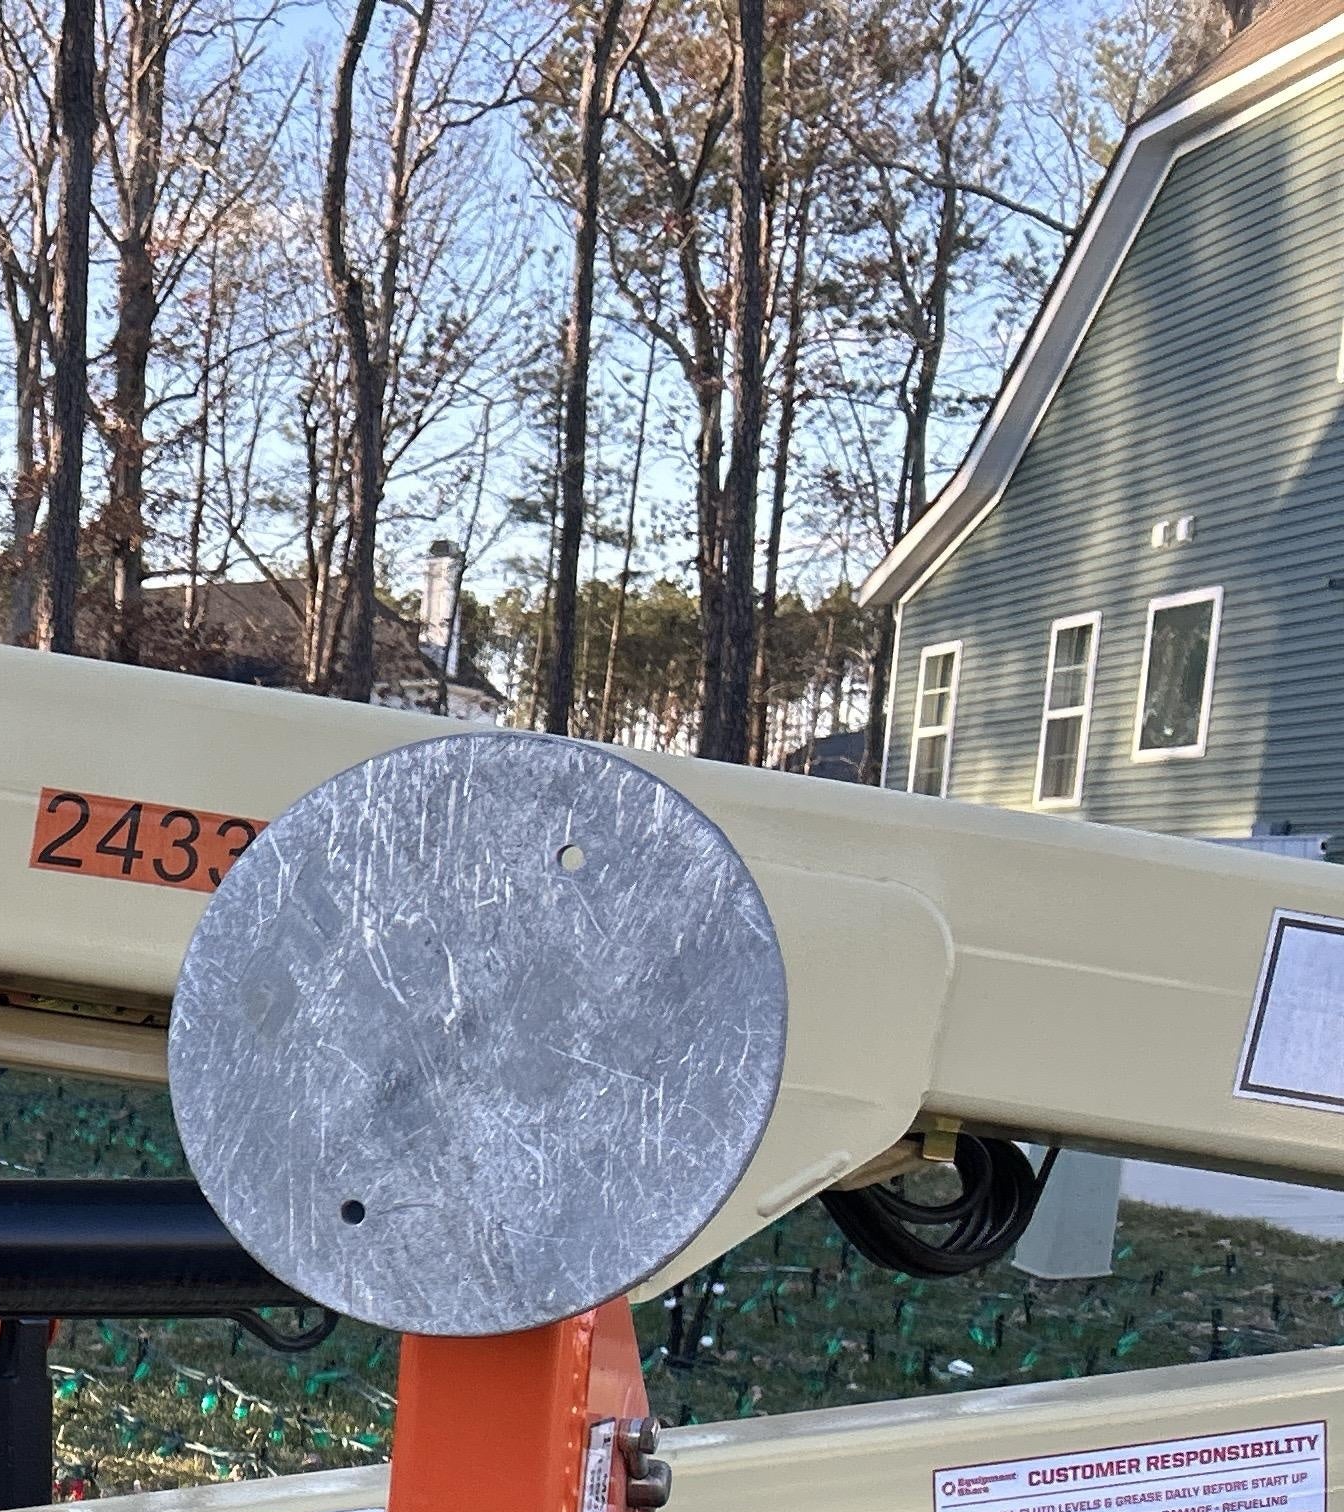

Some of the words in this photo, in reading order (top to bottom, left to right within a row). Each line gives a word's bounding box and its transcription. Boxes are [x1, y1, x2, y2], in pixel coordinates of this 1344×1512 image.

[1028, 1457, 1140, 1487] CUSTOMER
[1146, 1435, 1318, 1472] RESPONSIBILITY
[1115, 1491, 1163, 1507] GREASE
[1165, 1487, 1199, 1501] DAILY
[1203, 1480, 1248, 1496] BEFORE
[1251, 1474, 1288, 1489] START
[1292, 1472, 1308, 1484] UP
[1222, 1495, 1288, 1512] REFUELING
